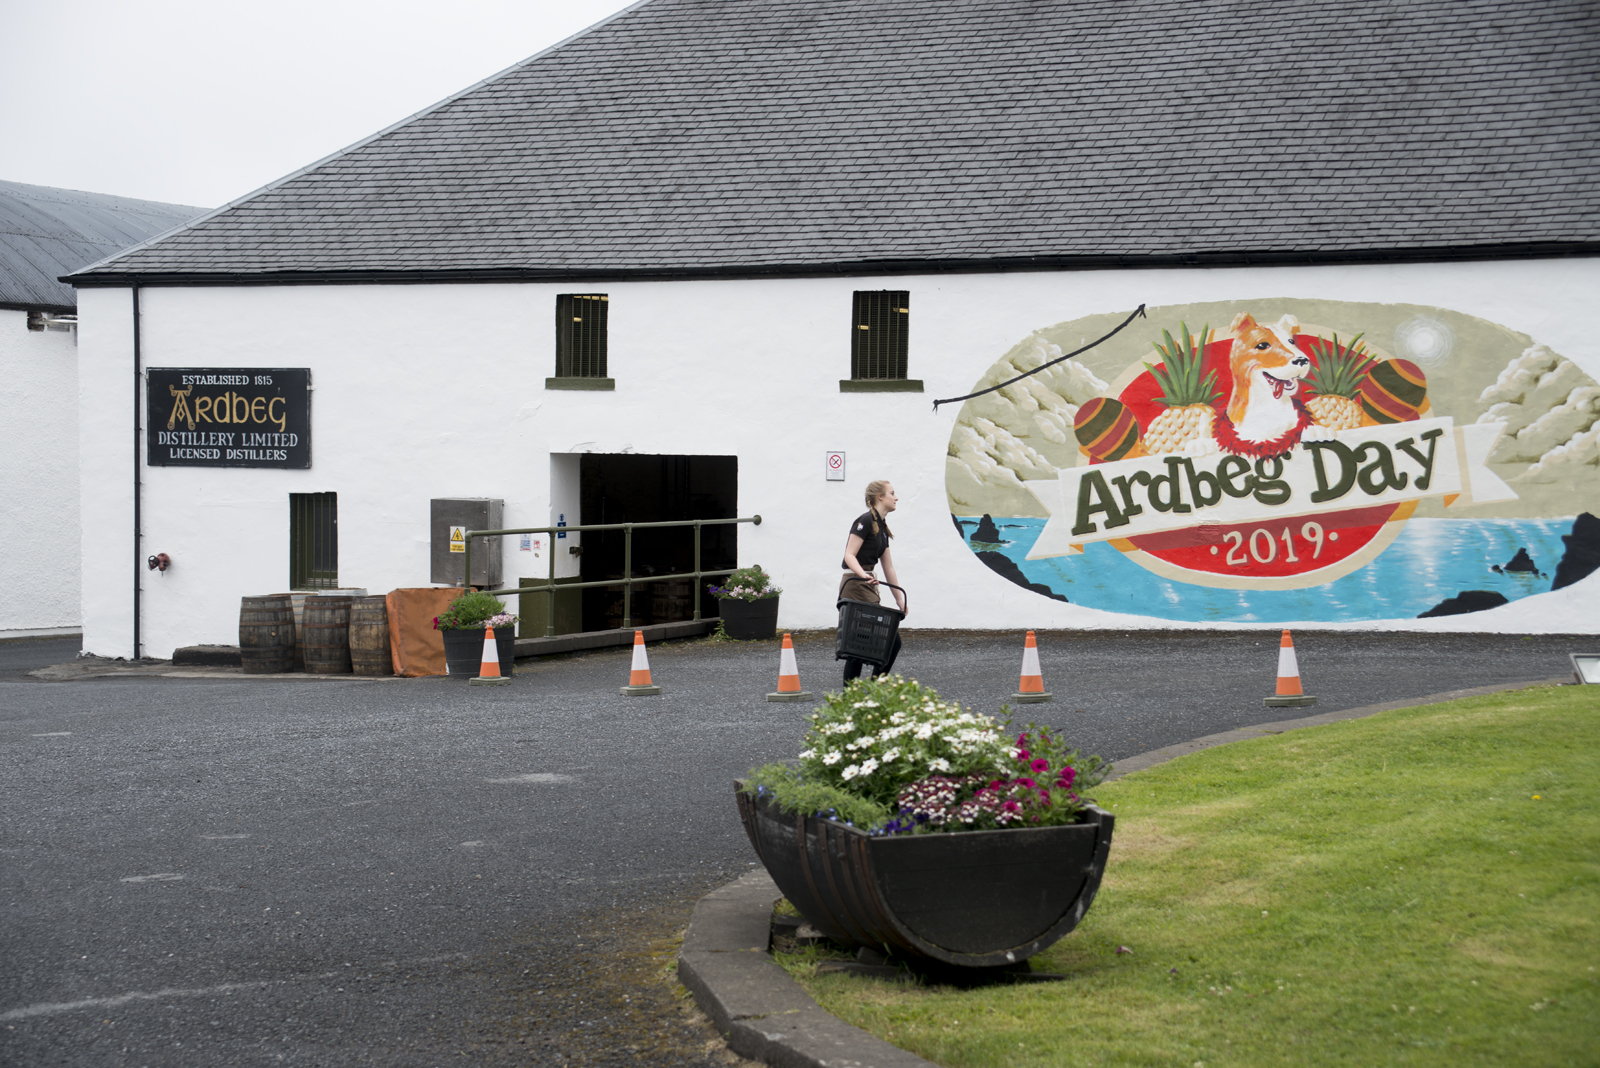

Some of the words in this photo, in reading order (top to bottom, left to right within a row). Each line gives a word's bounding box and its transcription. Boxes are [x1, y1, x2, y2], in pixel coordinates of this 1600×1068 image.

[182, 375, 250, 385] ESTABLISHED
[254, 375, 273, 385] 1815
[158, 431, 235, 446] DISTILLERY
[242, 432, 298, 447] LIMITED
[170, 448, 221, 459] LICENSED
[226, 449, 287, 461] DISTILLERS
[1071, 452, 1292, 536] Ardbeg
[1303, 428, 1443, 503] Day
